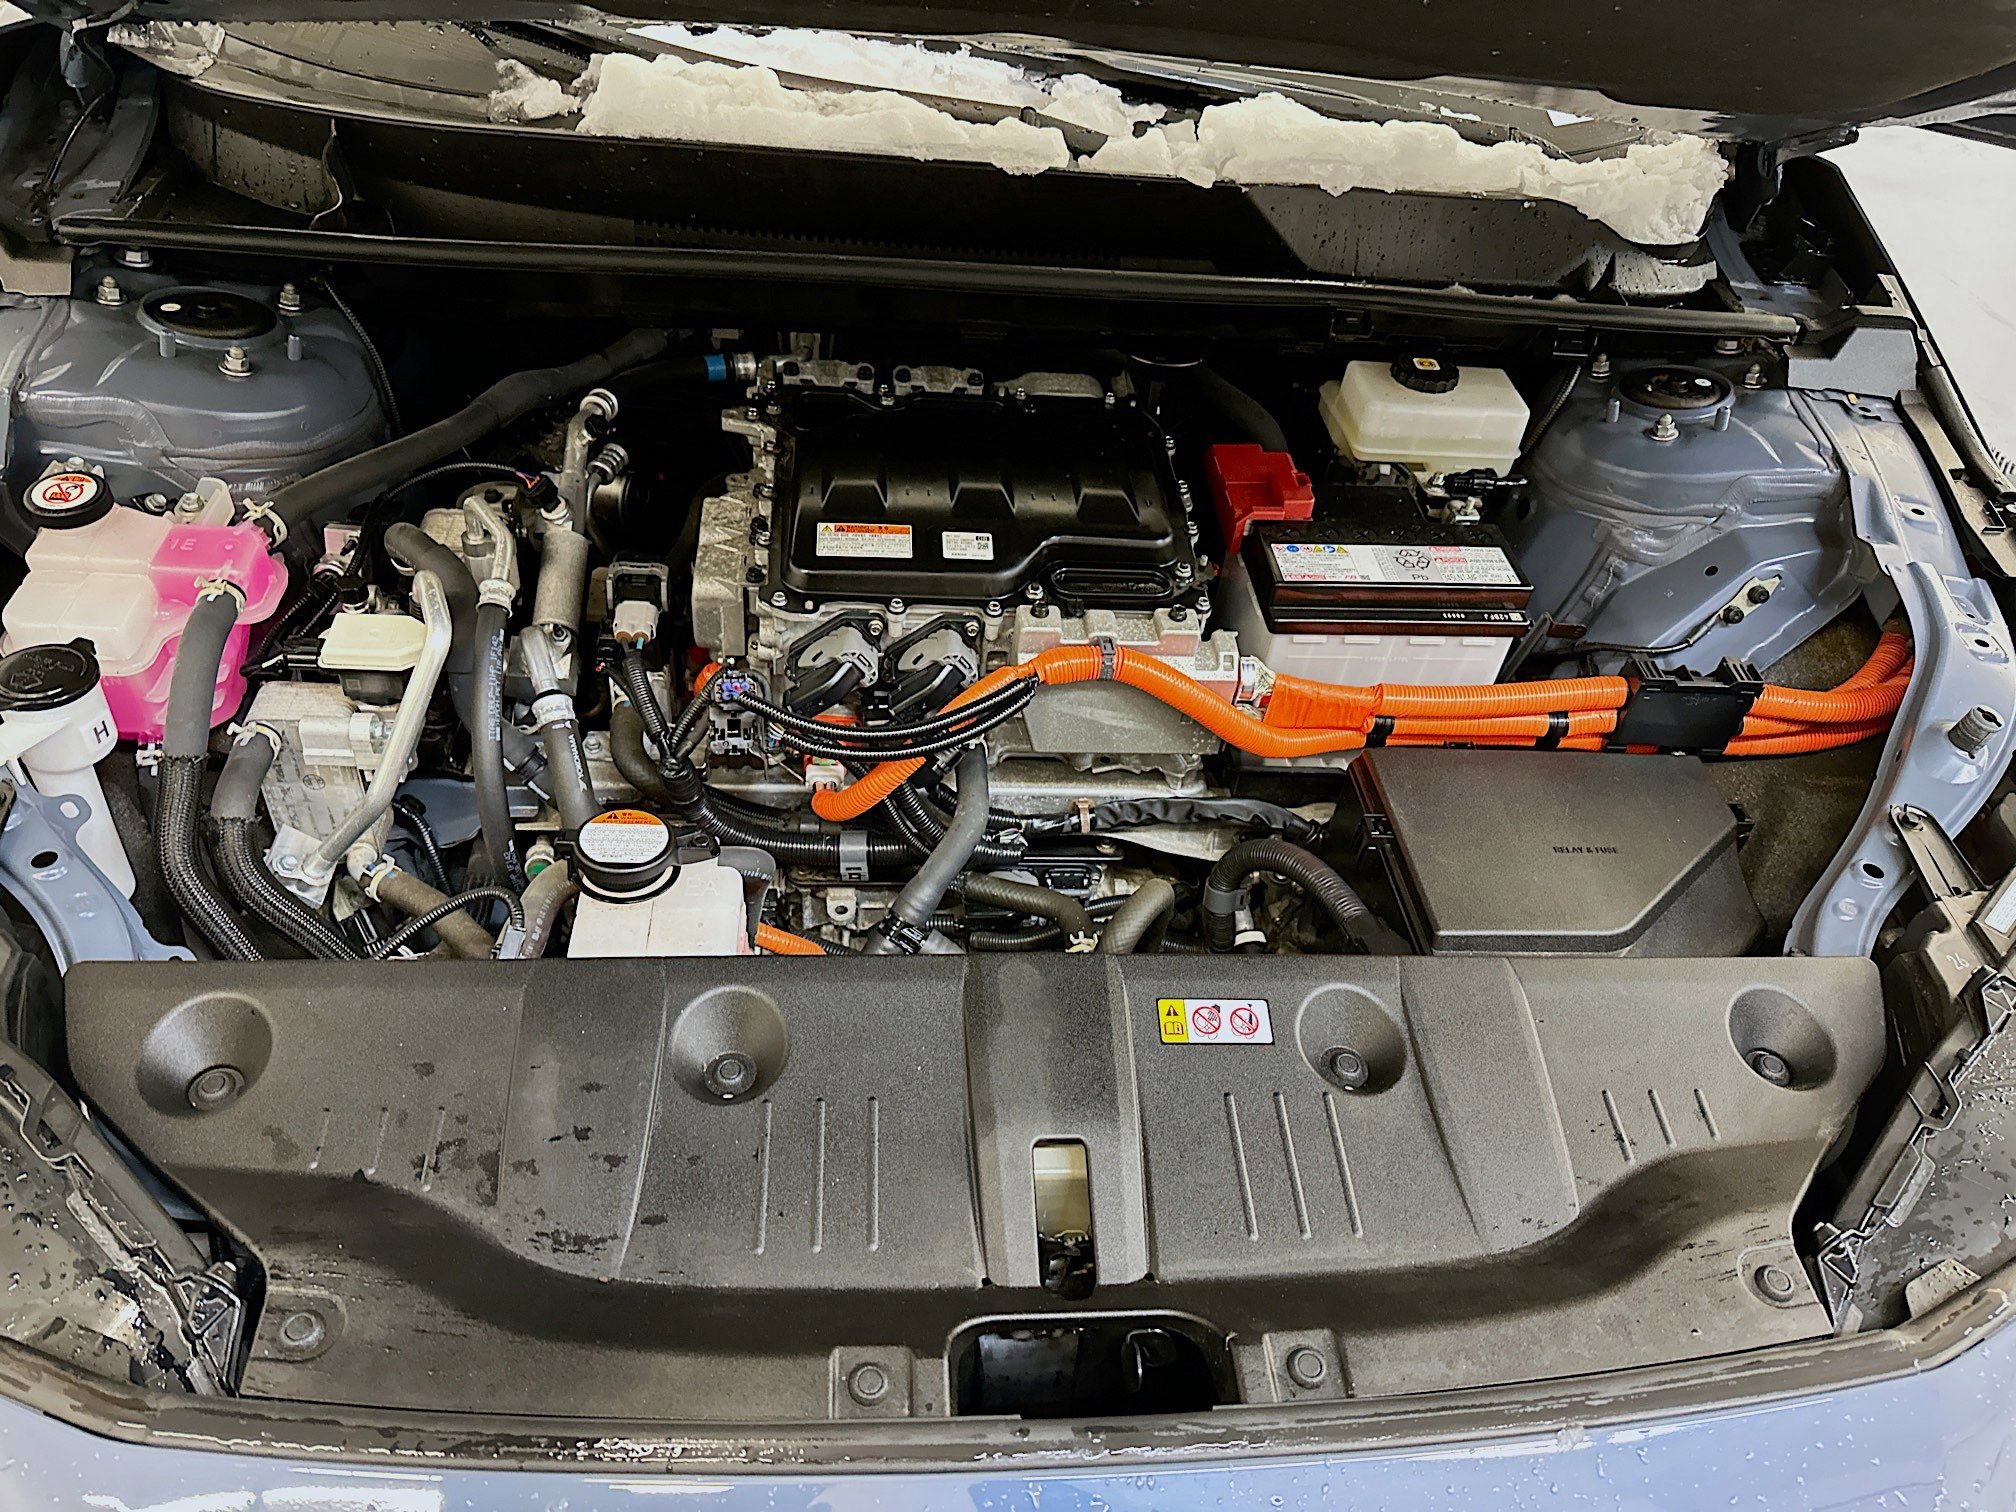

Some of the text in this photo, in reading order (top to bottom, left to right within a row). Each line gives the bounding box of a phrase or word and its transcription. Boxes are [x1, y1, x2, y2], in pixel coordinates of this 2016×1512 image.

[1411, 573, 1429, 581] Pb
[93, 720, 110, 744] H
[568, 734, 583, 780] YOKOHAMA
[1552, 845, 1618, 854] RELAY & FUSE
